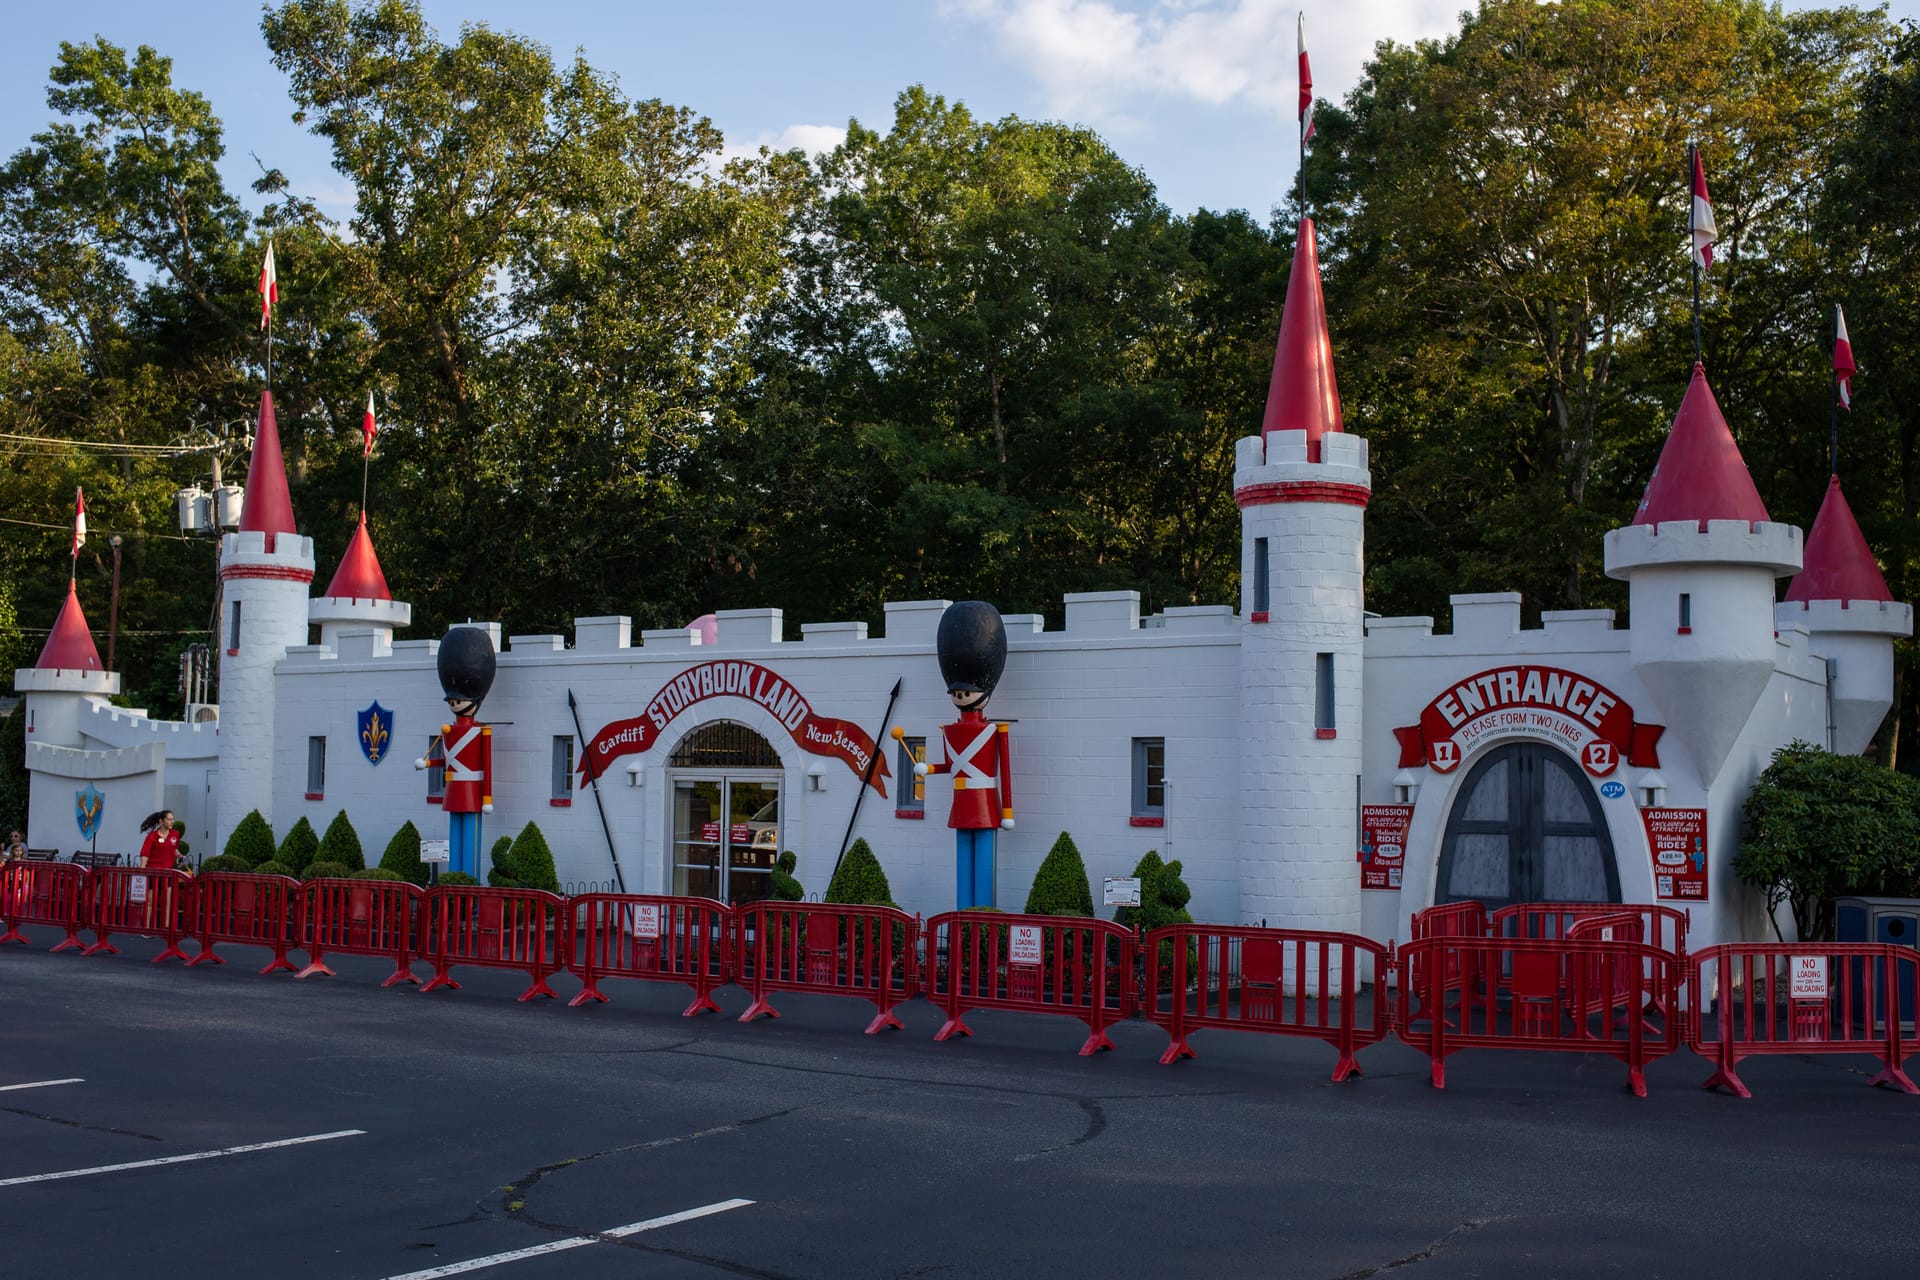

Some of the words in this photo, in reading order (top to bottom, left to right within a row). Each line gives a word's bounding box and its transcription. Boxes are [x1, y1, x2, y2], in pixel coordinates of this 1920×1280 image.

[649, 662, 755, 731] STORYBOOK
[754, 671, 808, 732] LAND
[1436, 669, 1616, 728] ENTRANCE
[1462, 715, 1497, 741] PLEASE
[1500, 712, 1527, 725] FORM
[1531, 714, 1552, 728] TWO
[1554, 720, 1582, 742] LINES
[599, 725, 646, 755] Cardiff
[1466, 737, 1480, 752] STAY
[1481, 727, 1509, 740] TOGETHER
[1551, 731, 1578, 752] TOGETHER
[806, 723, 833, 743] New
[832, 730, 870, 771] Jersey
[1439, 746, 1449, 760] 1
[1593, 746, 1606, 763] 2
[1602, 785, 1623, 793] ATM
[1363, 808, 1409, 816] ADMISSION
[1648, 811, 1701, 820] ADMISSION
[1376, 835, 1402, 843] RIDES
[1657, 841, 1687, 849] RIDES
[641, 907, 652, 916] NO
[1019, 929, 1031, 937] NO
[1802, 958, 1816, 969] NO
[1797, 970, 1821, 978] LOADING
[1794, 985, 1825, 993] UNLOADING
